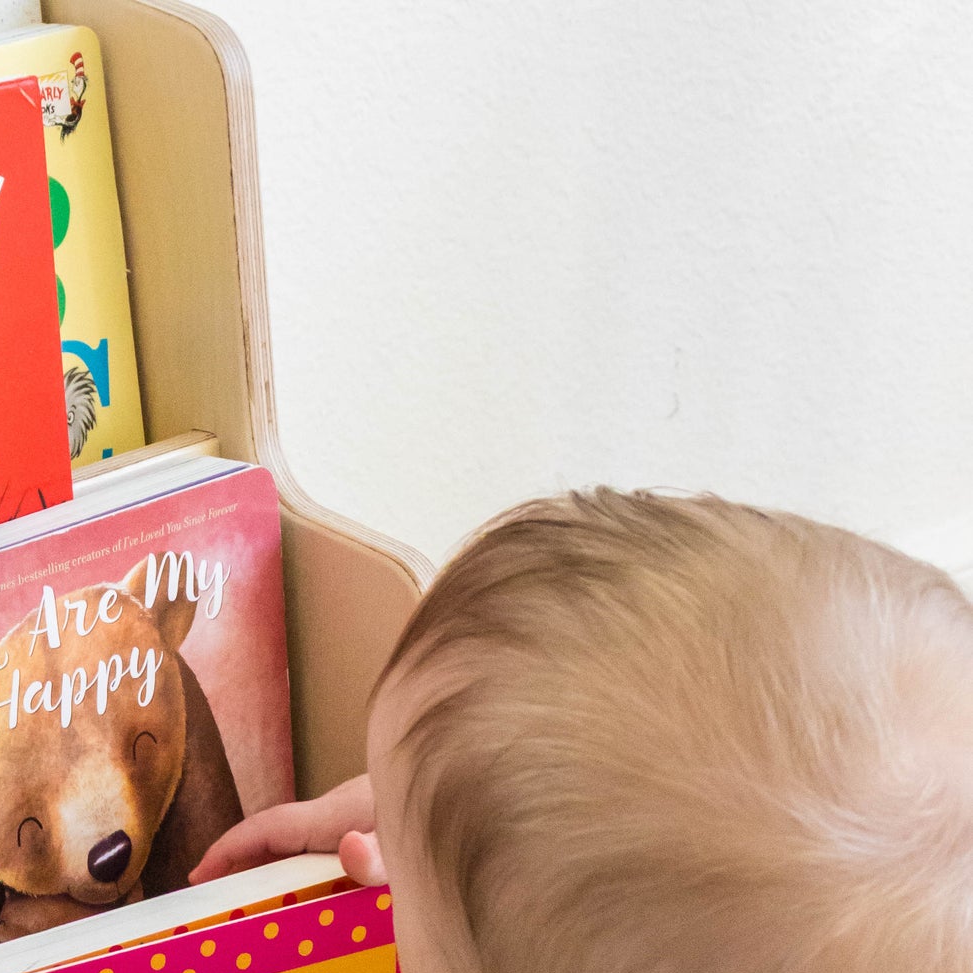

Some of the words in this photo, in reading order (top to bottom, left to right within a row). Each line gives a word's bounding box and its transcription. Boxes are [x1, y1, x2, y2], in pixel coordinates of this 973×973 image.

[17, 558, 71, 585] bestselling
[72, 546, 111, 566] creators
[112, 538, 123, 553] of
[140, 525, 165, 544] Loved
[166, 521, 182, 535] You
[183, 513, 207, 529] Since
[207, 502, 239, 521] Forever
[28, 585, 123, 656] Are
[144, 550, 231, 620] My
